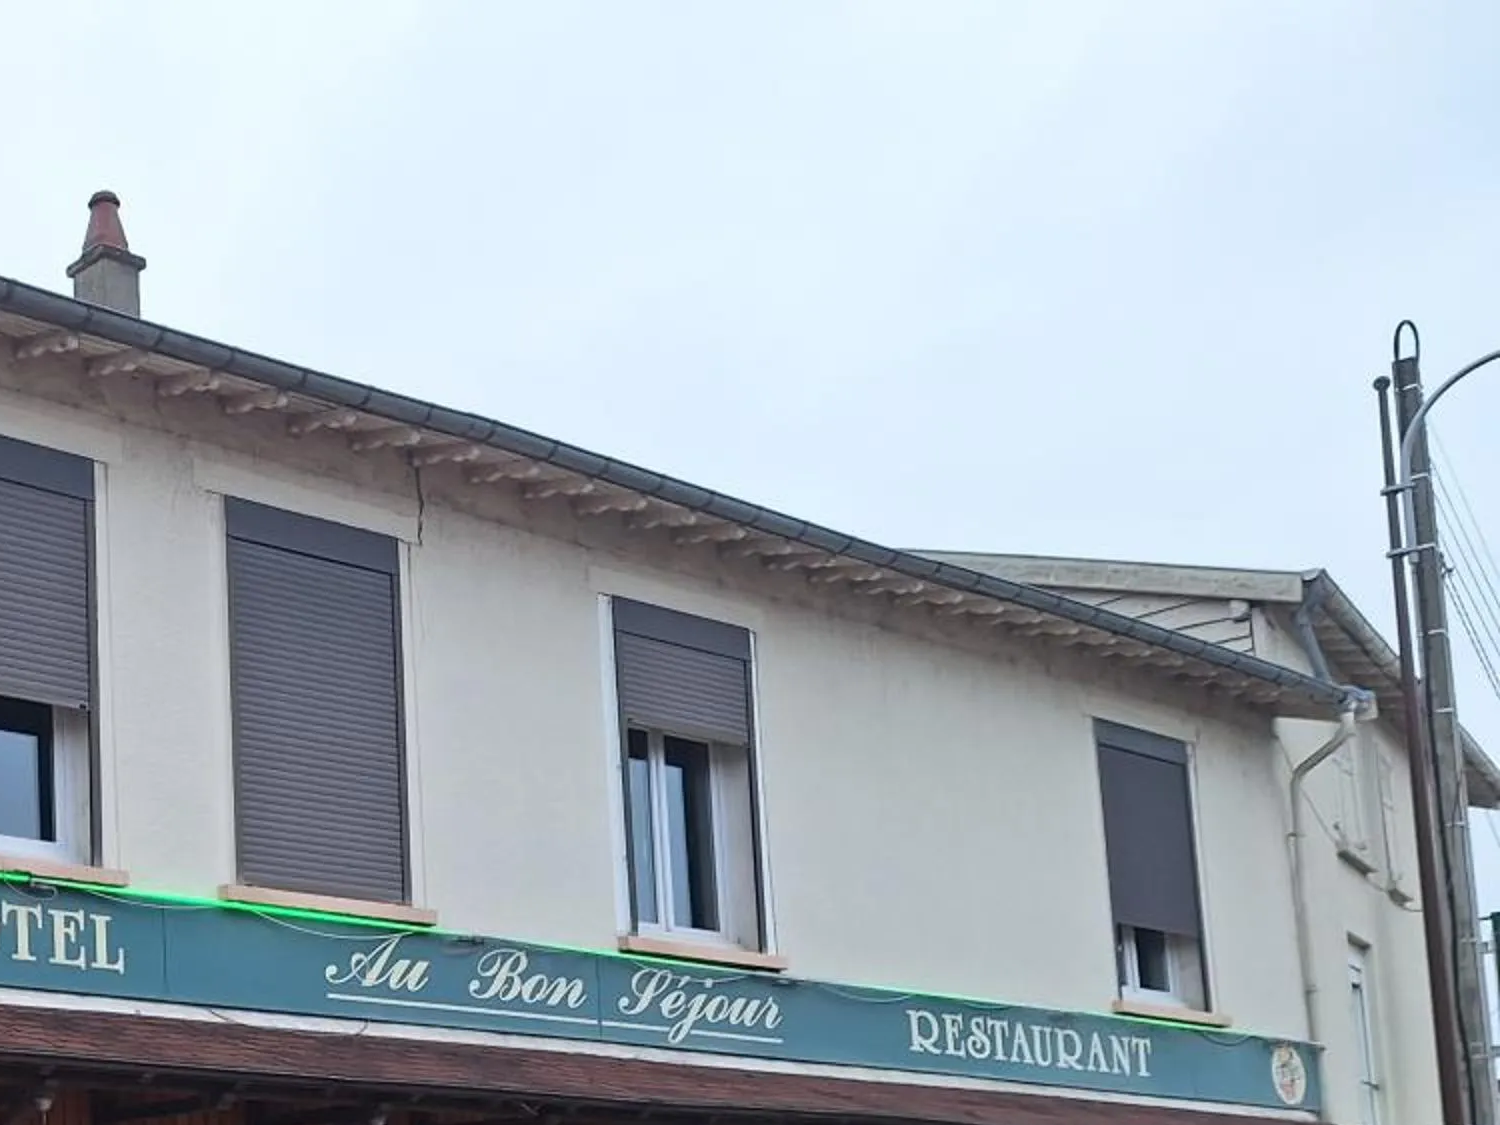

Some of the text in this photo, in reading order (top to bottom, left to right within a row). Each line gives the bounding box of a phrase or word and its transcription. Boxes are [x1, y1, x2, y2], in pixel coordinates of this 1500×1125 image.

[325, 933, 784, 1044] Au Bon Séjour
[905, 1009, 1152, 1077] RESTAURANT
